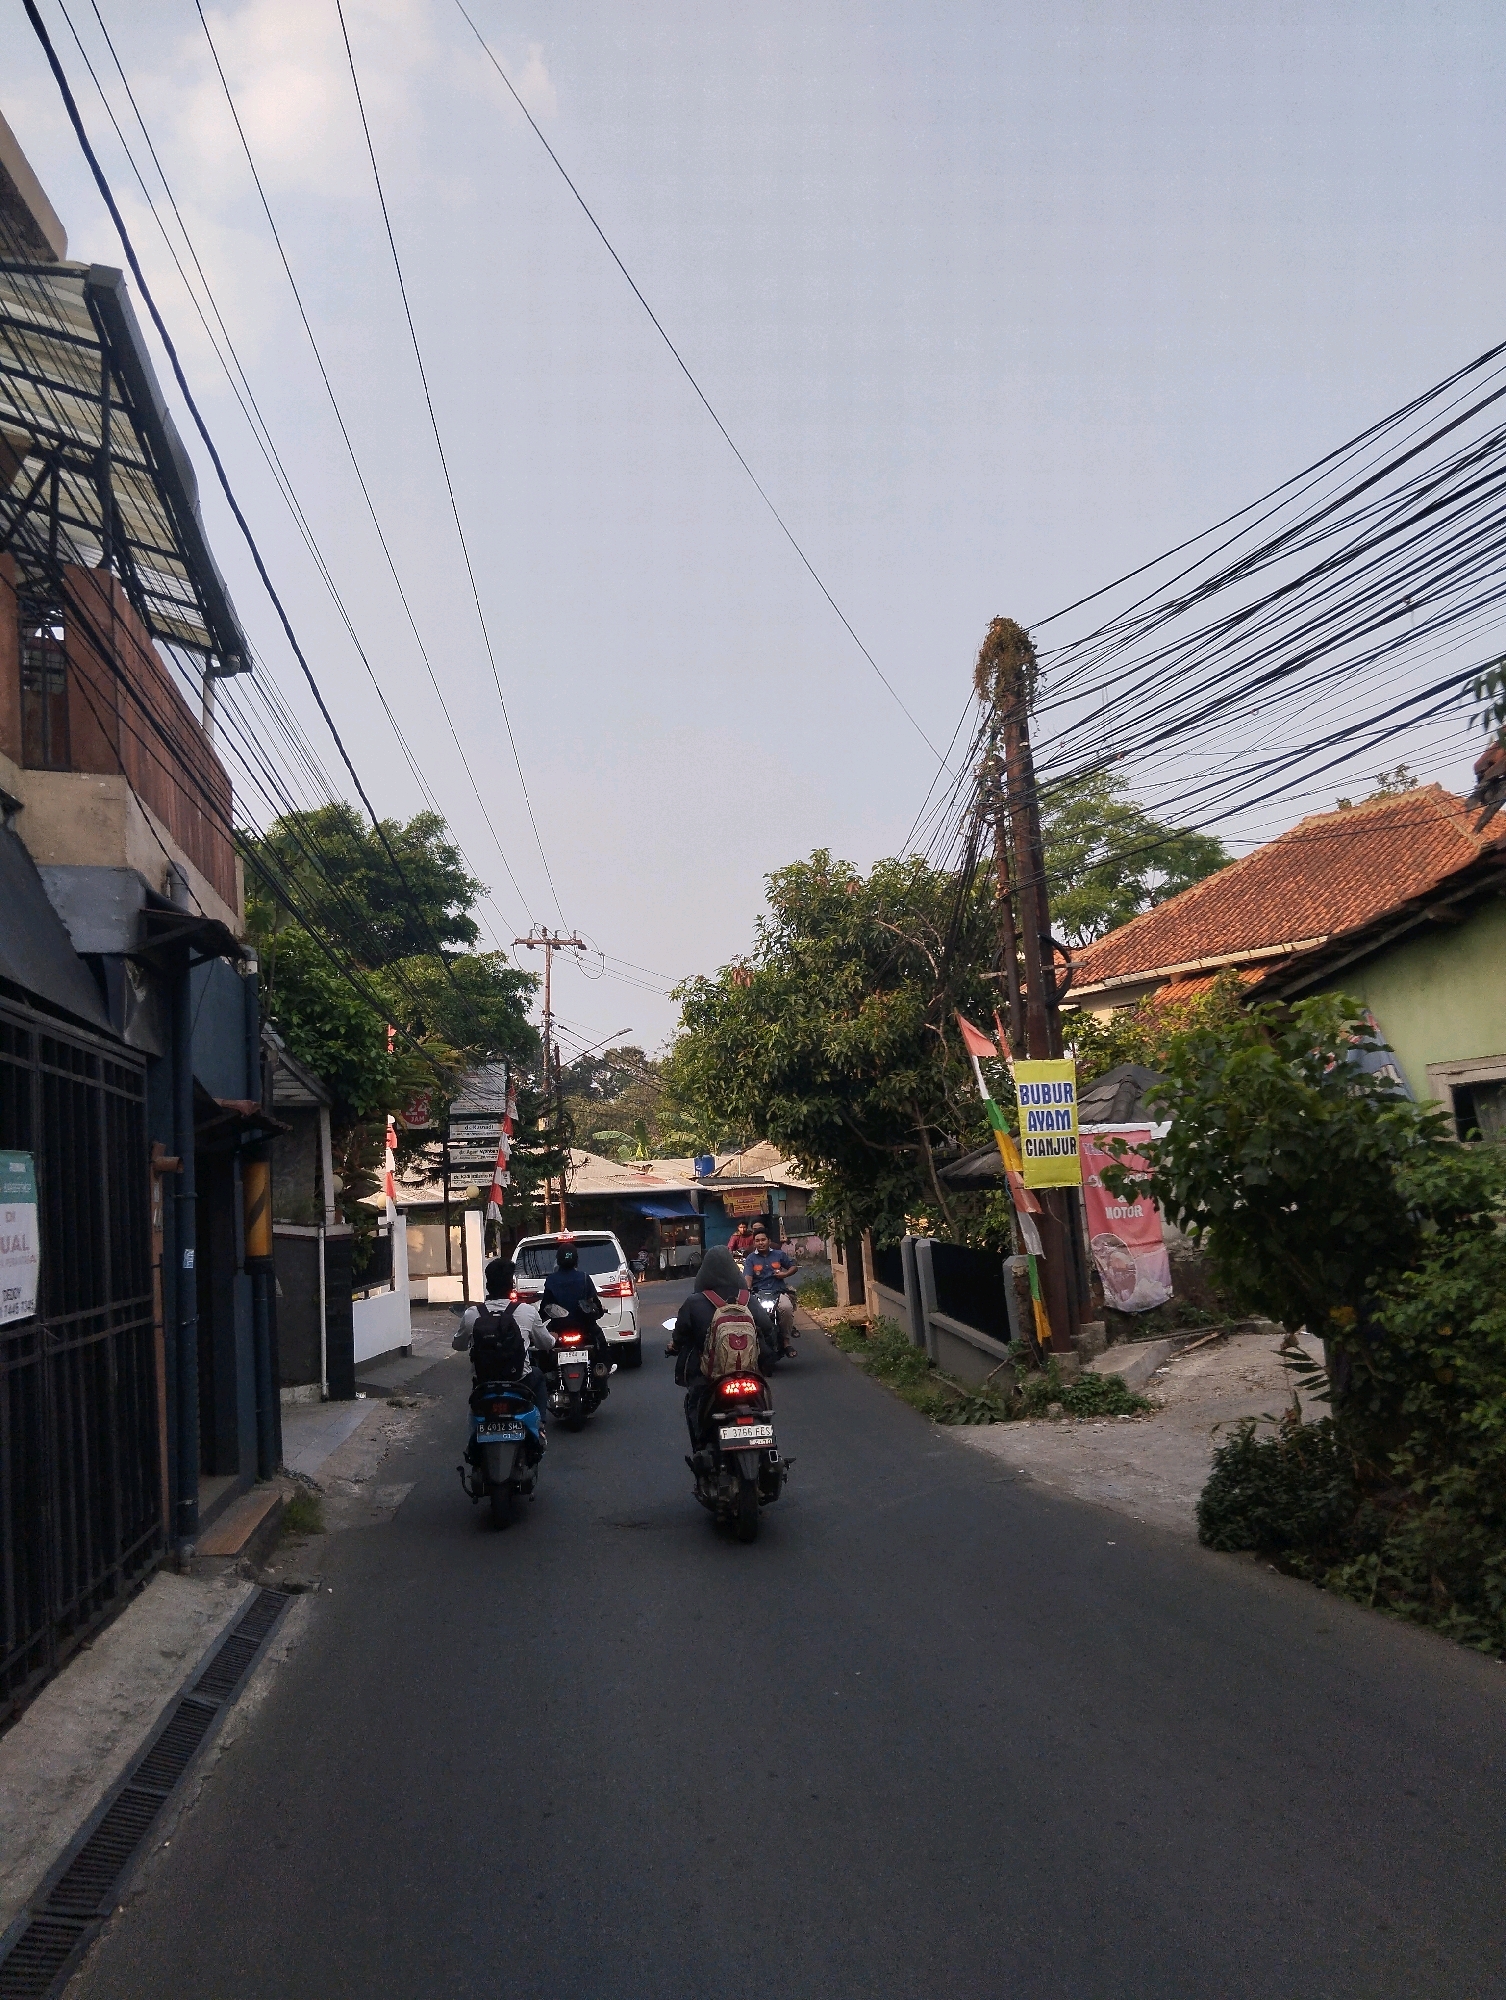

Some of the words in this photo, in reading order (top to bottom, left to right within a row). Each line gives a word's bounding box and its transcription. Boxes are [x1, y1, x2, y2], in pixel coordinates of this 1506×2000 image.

[1019, 1083, 1073, 1105] BUBUR
[1028, 1109, 1071, 1131] AYAM
[1025, 1137, 1077, 1156] CIANJUR
[1105, 1204, 1144, 1220] MOTOR
[479, 1424, 485, 1433] B
[722, 1429, 728, 1439] F
[733, 1428, 753, 1438] 3766
